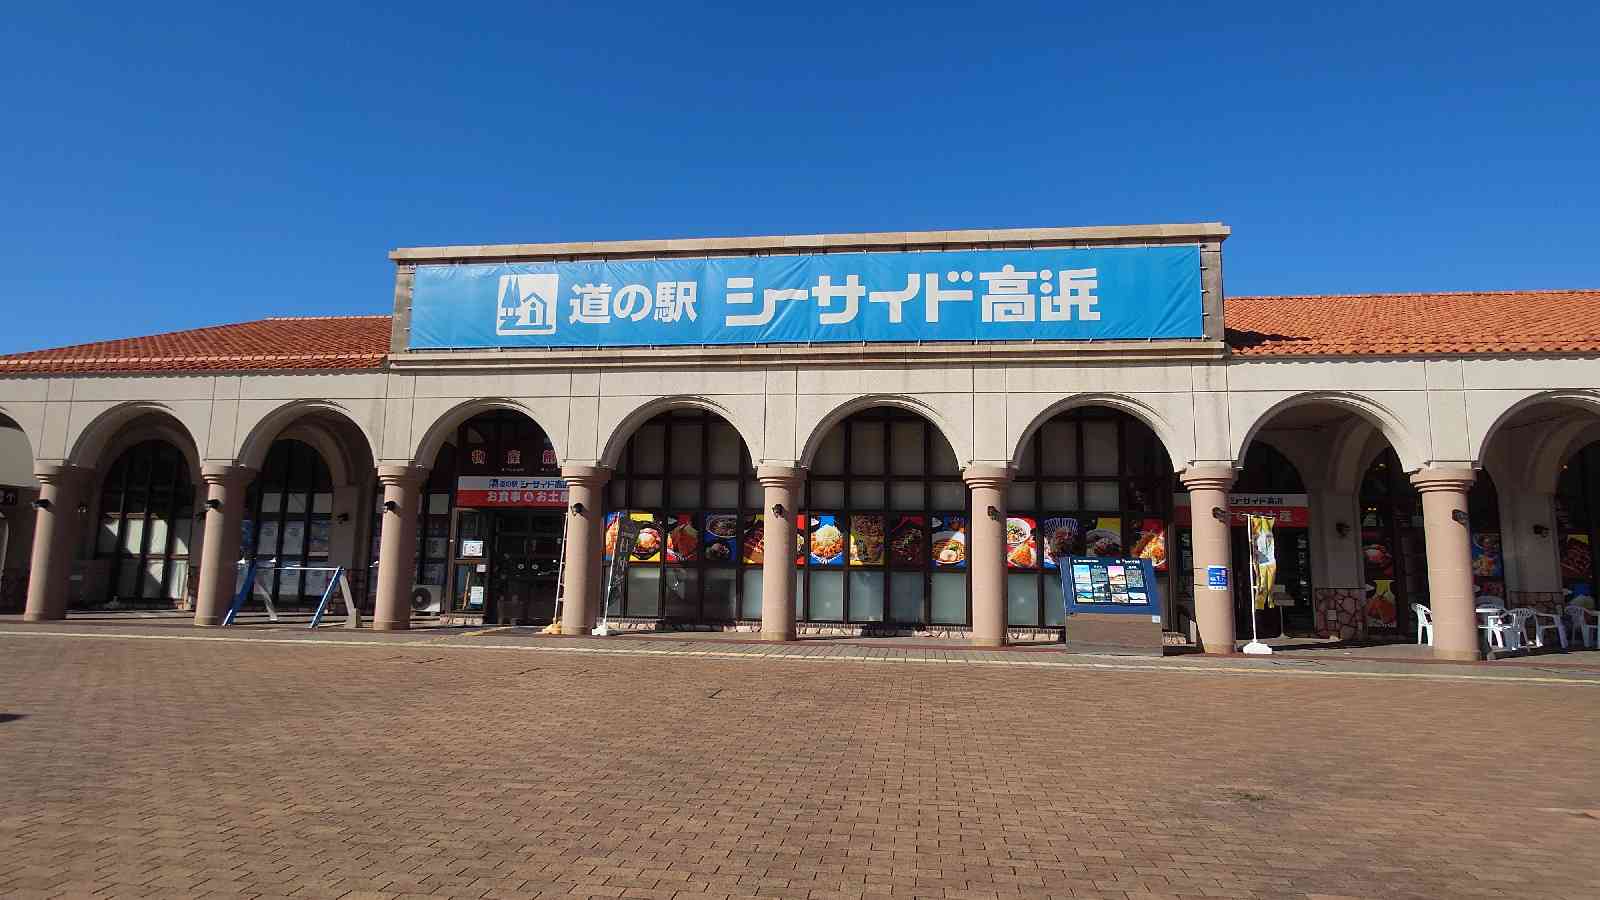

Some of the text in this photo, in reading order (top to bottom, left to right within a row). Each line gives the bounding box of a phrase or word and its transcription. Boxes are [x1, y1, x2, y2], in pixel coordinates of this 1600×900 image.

[568, 264, 1102, 328] 道の駅 シーサイド高浜
